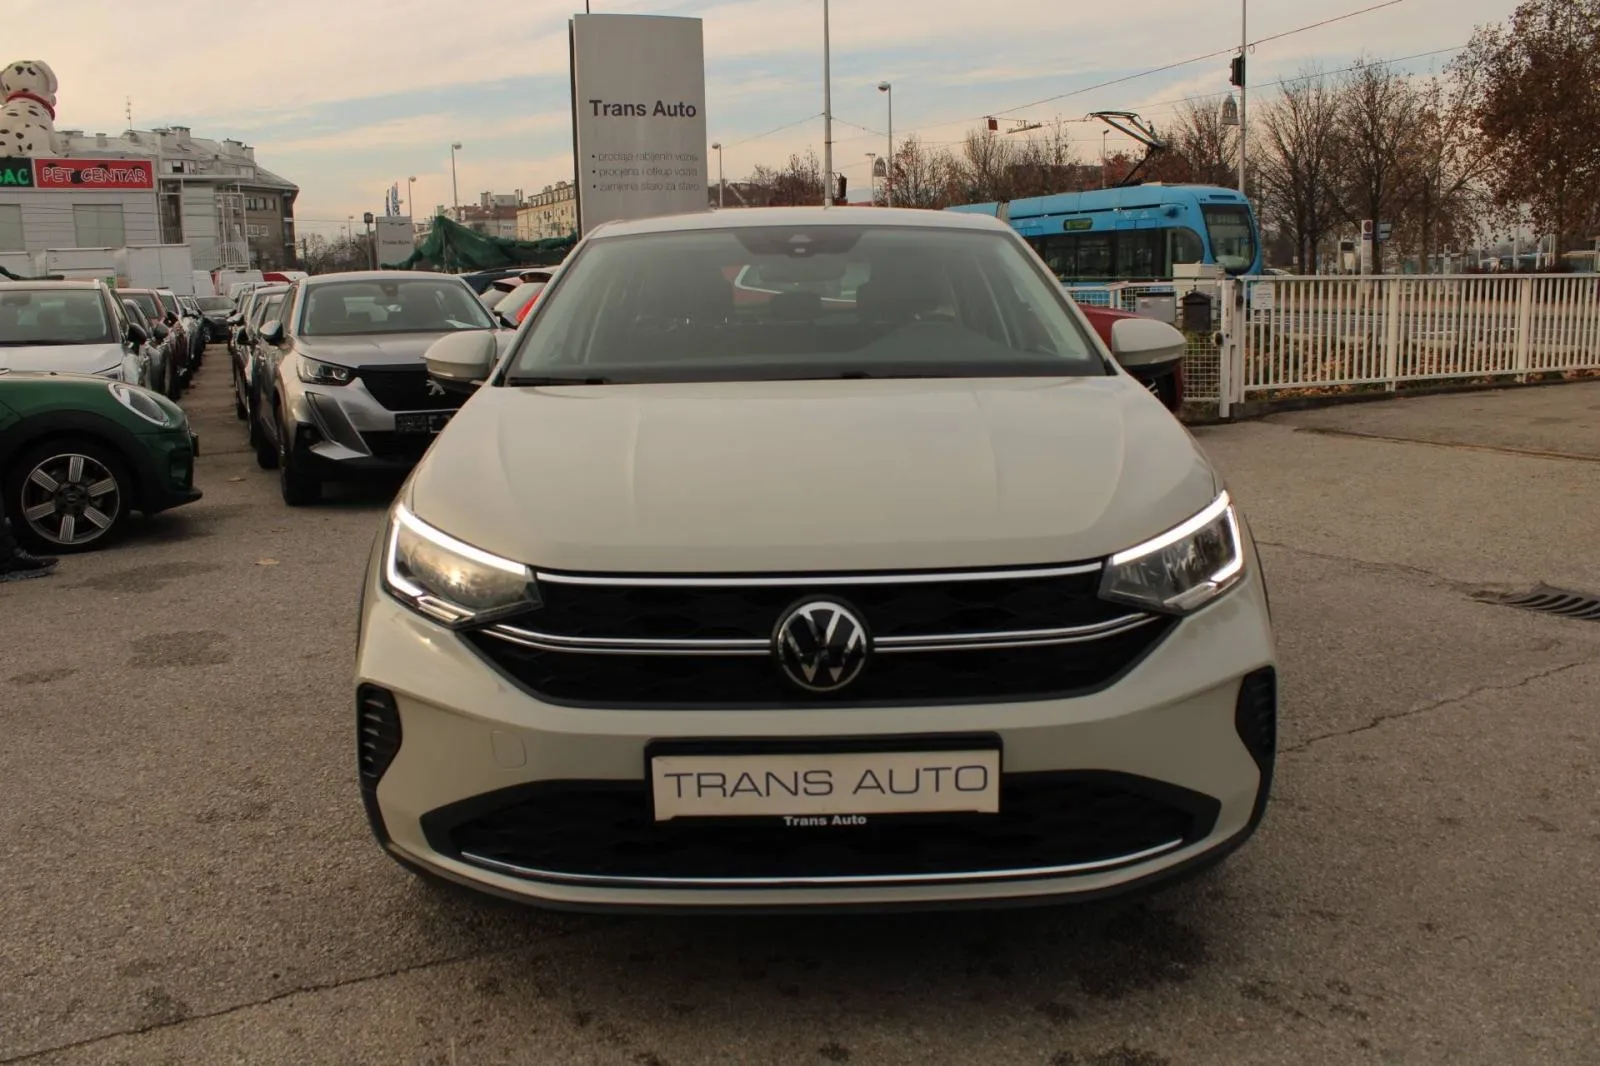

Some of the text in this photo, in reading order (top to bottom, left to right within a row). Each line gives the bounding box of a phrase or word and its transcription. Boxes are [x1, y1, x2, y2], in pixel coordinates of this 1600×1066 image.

[589, 99, 697, 118] Trans Auto
[42, 167, 147, 183] PET CENTAR
[663, 765, 988, 799] TRANS AUTO
[783, 814, 867, 827] Trans Auto
